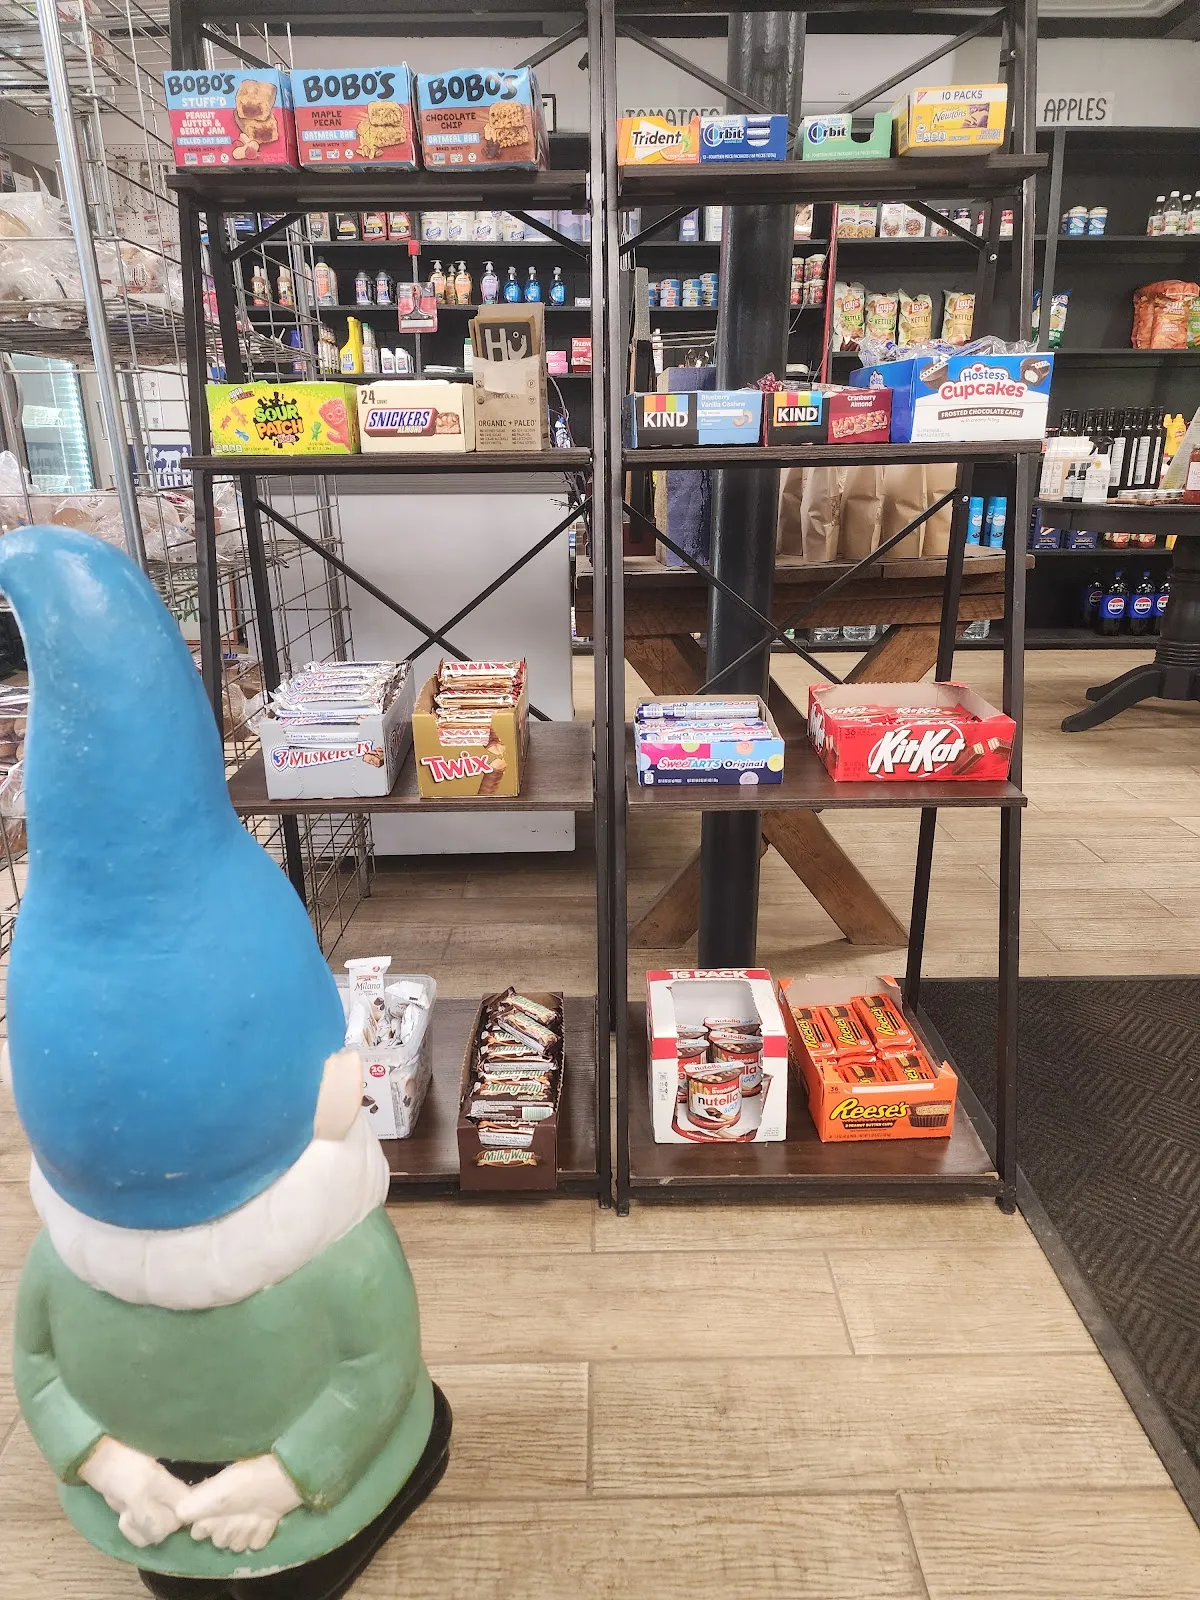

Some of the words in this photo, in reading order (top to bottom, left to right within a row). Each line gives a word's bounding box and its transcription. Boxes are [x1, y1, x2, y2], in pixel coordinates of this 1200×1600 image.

[167, 73, 236, 96] BOBO'S
[303, 71, 396, 102] BOBO'S
[428, 72, 519, 105] BOBO'S
[942, 91, 951, 100] 10
[954, 90, 983, 100] PACKS
[182, 97, 227, 107] STUFF'D
[185, 112, 215, 120] PEANUT
[312, 111, 342, 119] MAPLE
[933, 110, 967, 123] Newtons
[1043, 98, 1106, 122] APPLES
[215, 119, 222, 127] &
[314, 119, 342, 127] PECAN
[426, 112, 477, 122] CHOCOLATE
[180, 127, 205, 135] BERRY
[207, 127, 226, 135] JAM
[441, 121, 463, 129] CHIP
[304, 131, 338, 141] OATMEAL
[340, 130, 355, 139] BAR
[428, 134, 462, 143] OATMEAL
[464, 134, 478, 143] BAR
[633, 131, 682, 145] Trident
[703, 123, 744, 147] Orbit
[807, 121, 847, 145] Orbit
[963, 370, 1006, 381] Hostess
[361, 390, 375, 404] 24
[940, 382, 1025, 400] Cupcakes
[254, 404, 299, 423] SOUR
[368, 411, 430, 427] SNICKERS
[644, 412, 689, 428] KIND
[778, 407, 818, 422] KIND
[941, 409, 968, 418] FROSTED
[255, 419, 304, 438] PATCH
[397, 425, 423, 434] ALMOND
[274, 751, 288, 768] 3
[422, 751, 492, 781] Twix
[724, 760, 764, 769] Original
[669, 971, 692, 979] 16
[693, 971, 750, 979] PACK
[354, 982, 381, 991] Milano
[489, 1084, 518, 1095] Milky
[698, 1093, 739, 1107] nutella
[829, 1098, 909, 1121] Reese's
[484, 1151, 511, 1164] Milky
[511, 1150, 530, 1162] Way
